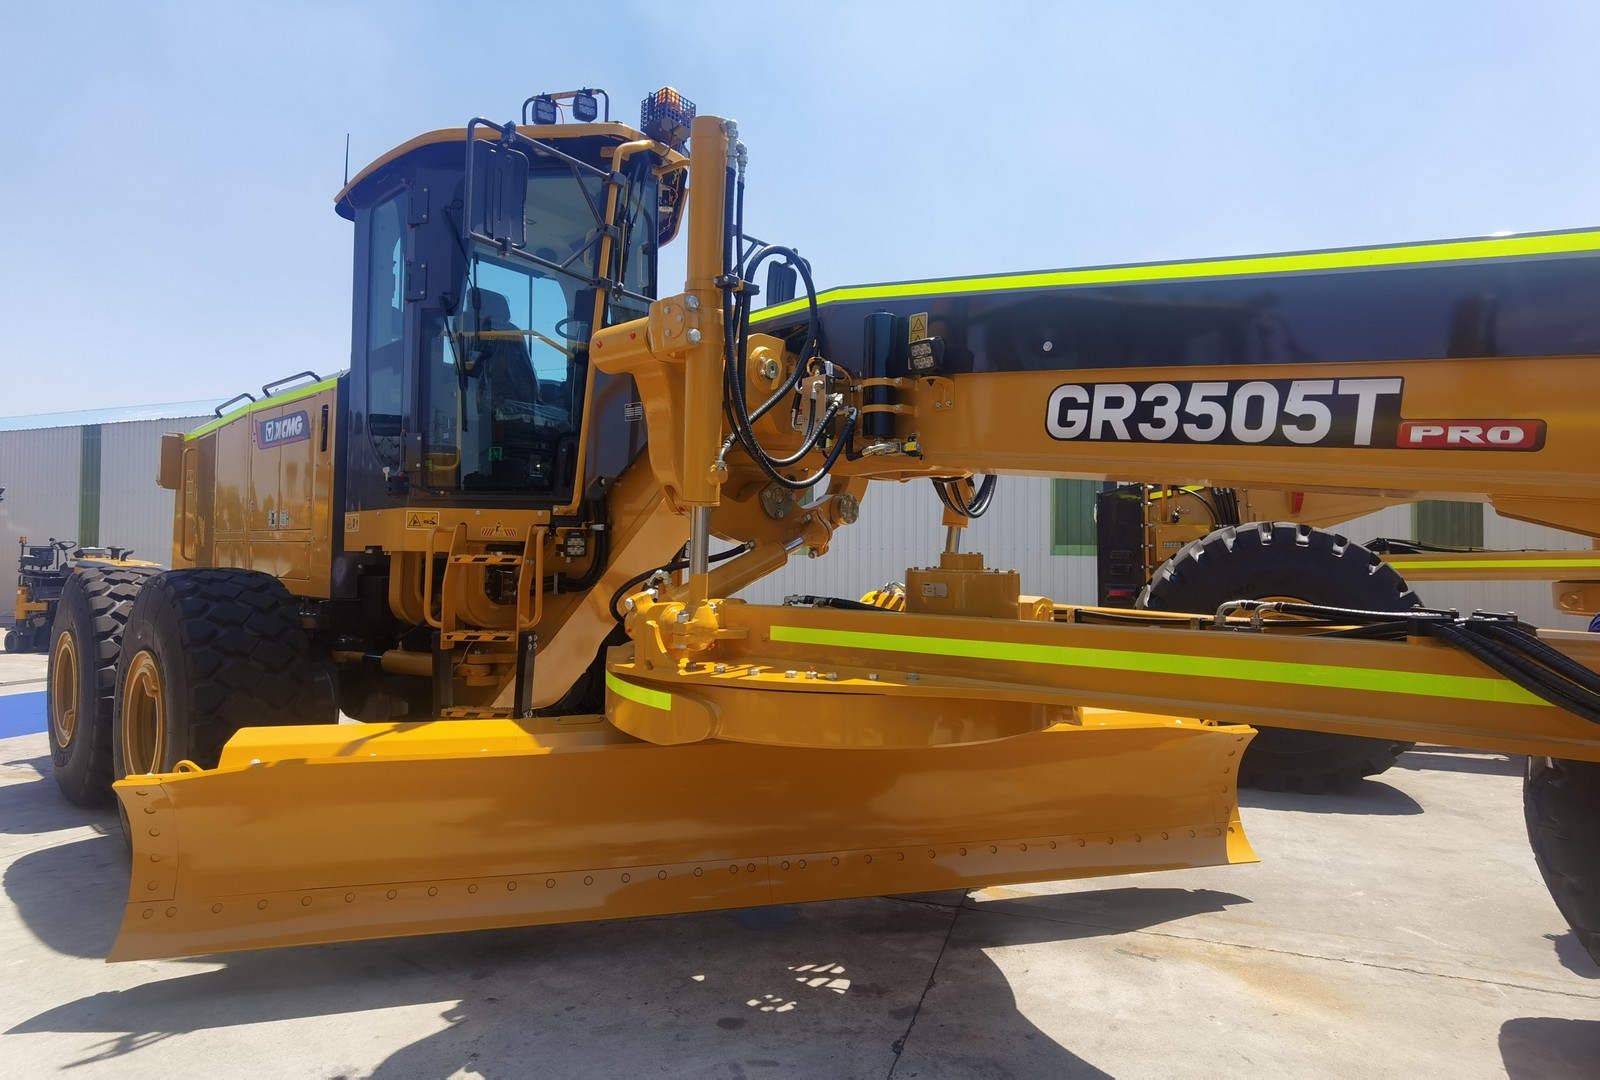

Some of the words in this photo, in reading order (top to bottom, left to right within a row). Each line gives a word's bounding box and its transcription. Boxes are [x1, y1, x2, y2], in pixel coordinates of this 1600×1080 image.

[1047, 378, 1402, 446] GR3505T
[274, 415, 303, 440] XCMG
[1409, 425, 1525, 444] PRO
